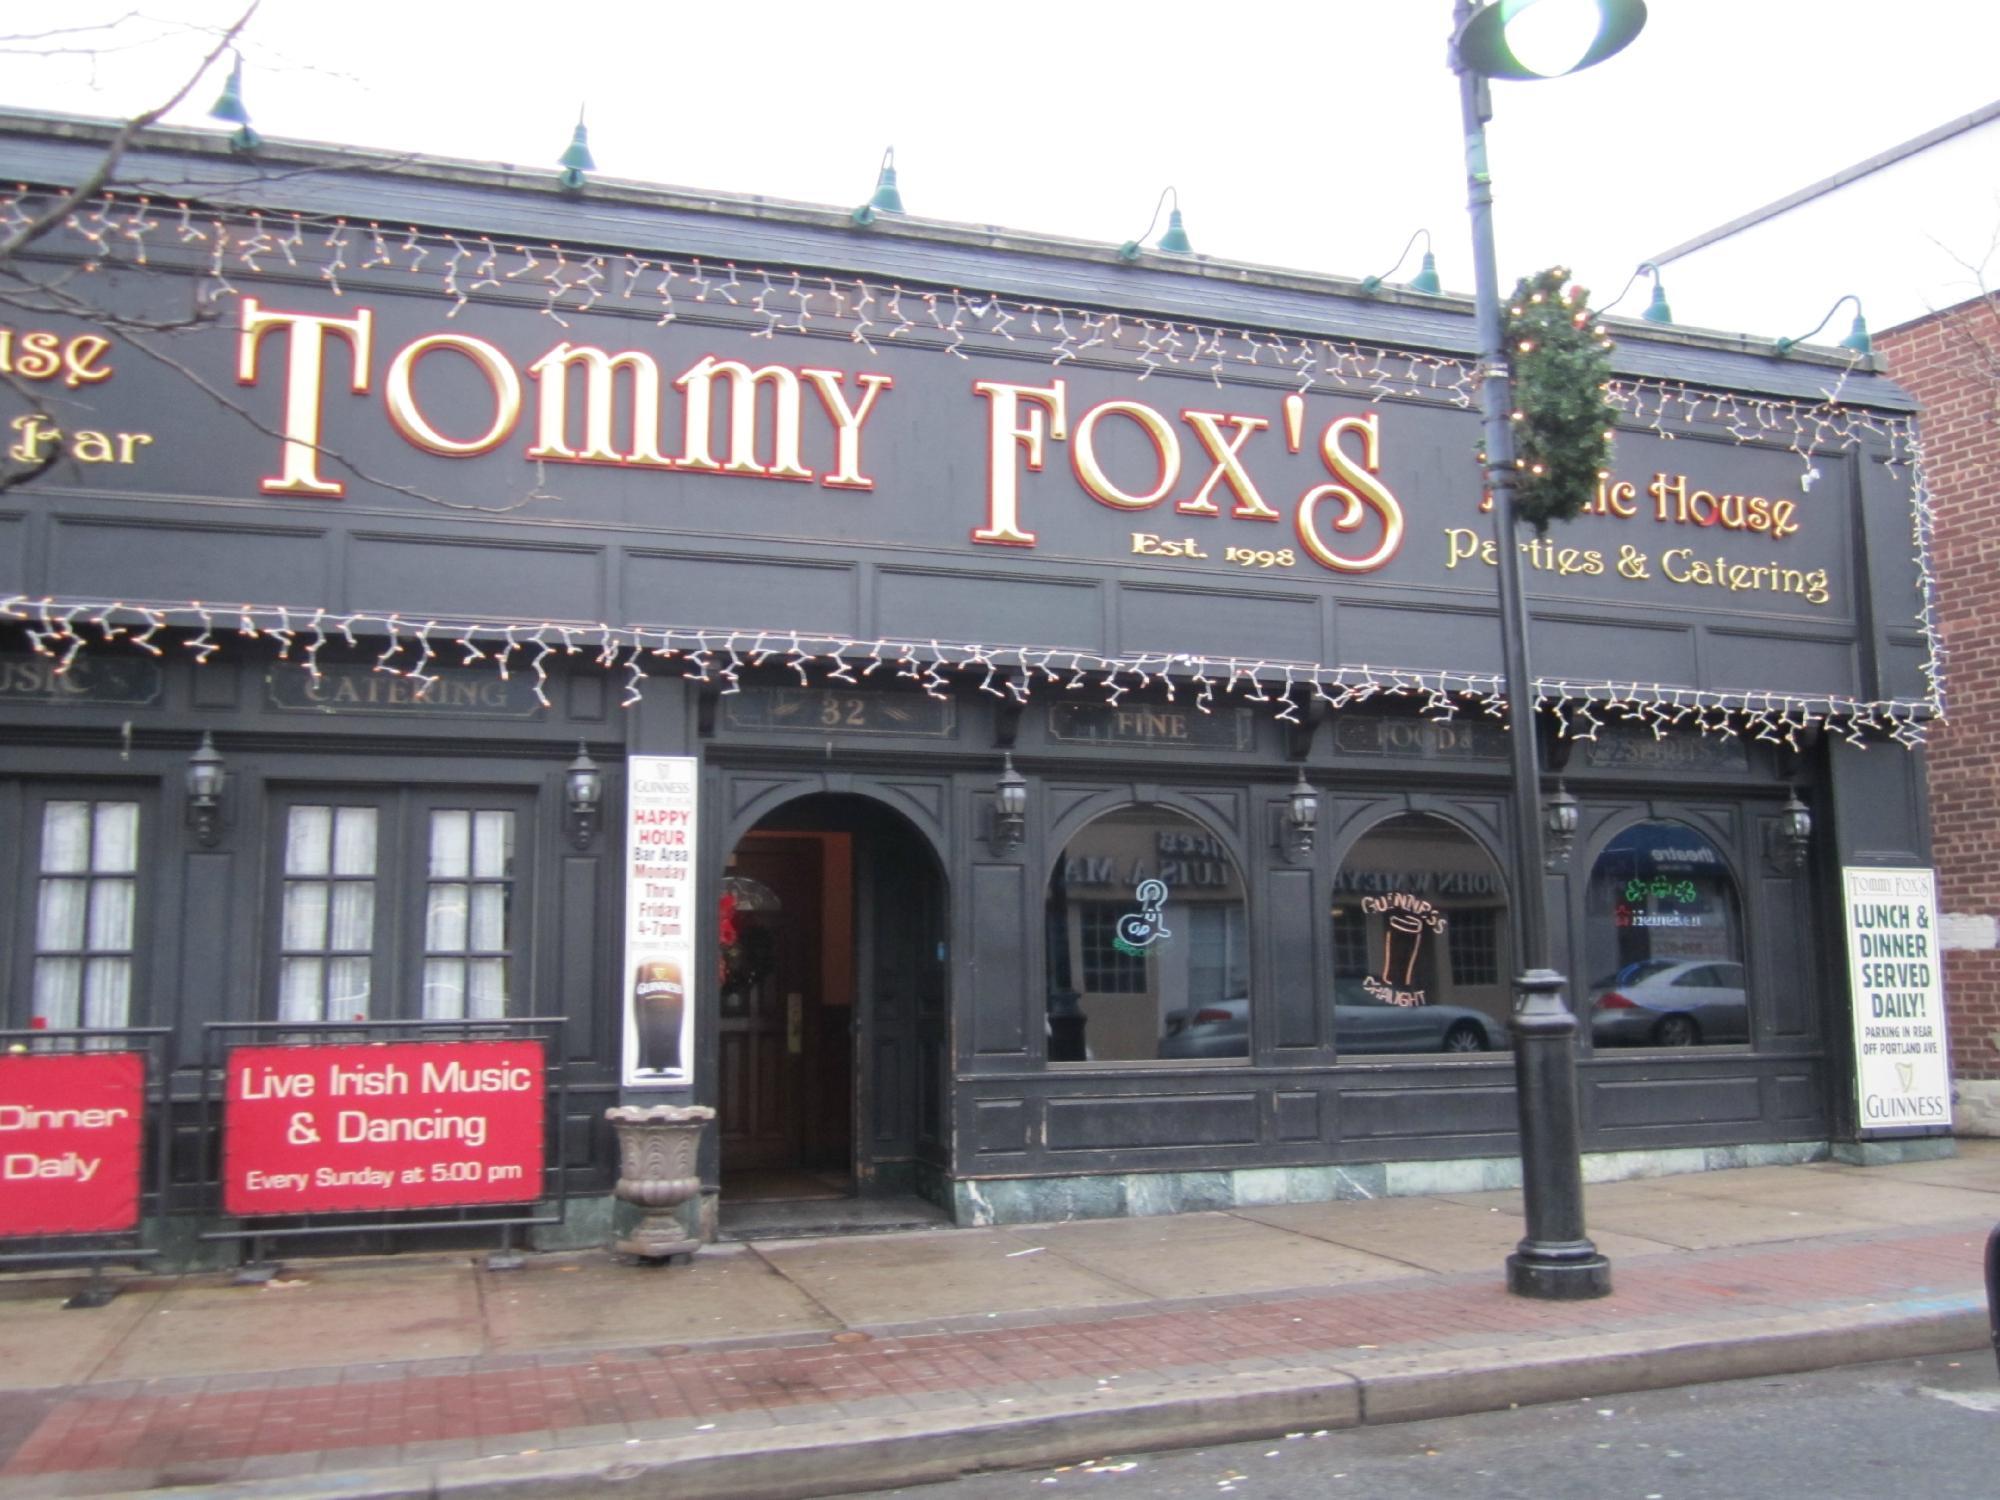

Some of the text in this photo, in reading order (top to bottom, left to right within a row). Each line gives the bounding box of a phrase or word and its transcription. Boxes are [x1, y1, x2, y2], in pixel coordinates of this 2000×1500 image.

[970, 378, 1404, 574] FOX'S
[1648, 472, 1799, 540] House
[1131, 532, 1296, 568] Est. 1998
[1617, 544, 1650, 580] &
[1662, 547, 1830, 604] Catering
[304, 677, 508, 706] CATERING
[821, 699, 865, 727] 32
[1116, 710, 1190, 739] FINE
[634, 808, 691, 826] HAPPY
[639, 829, 685, 846] HOUR
[634, 847, 688, 862] Bar Area
[638, 902, 681, 918] Friday
[1853, 903, 1929, 929] LUNCH &
[1860, 933, 1928, 958] DINNER
[1861, 963, 1930, 988] SERVED
[1871, 993, 1926, 1018] DAILY!
[1865, 1026, 1933, 1038] PARKING IN REAR
[1863, 1042, 1938, 1055] OFF PORTLAND AVE
[241, 1060, 532, 1100] Live Irish Music
[0, 1104, 129, 1130] Dinner
[1866, 1093, 1944, 1118] GUINNESS
[287, 1108, 487, 1147] & Dancing
[4, 1151, 102, 1182] Daily
[245, 1169, 310, 1192] Every
[315, 1166, 395, 1189] Sunday
[401, 1168, 426, 1184] at
[487, 1163, 523, 1183] pm
